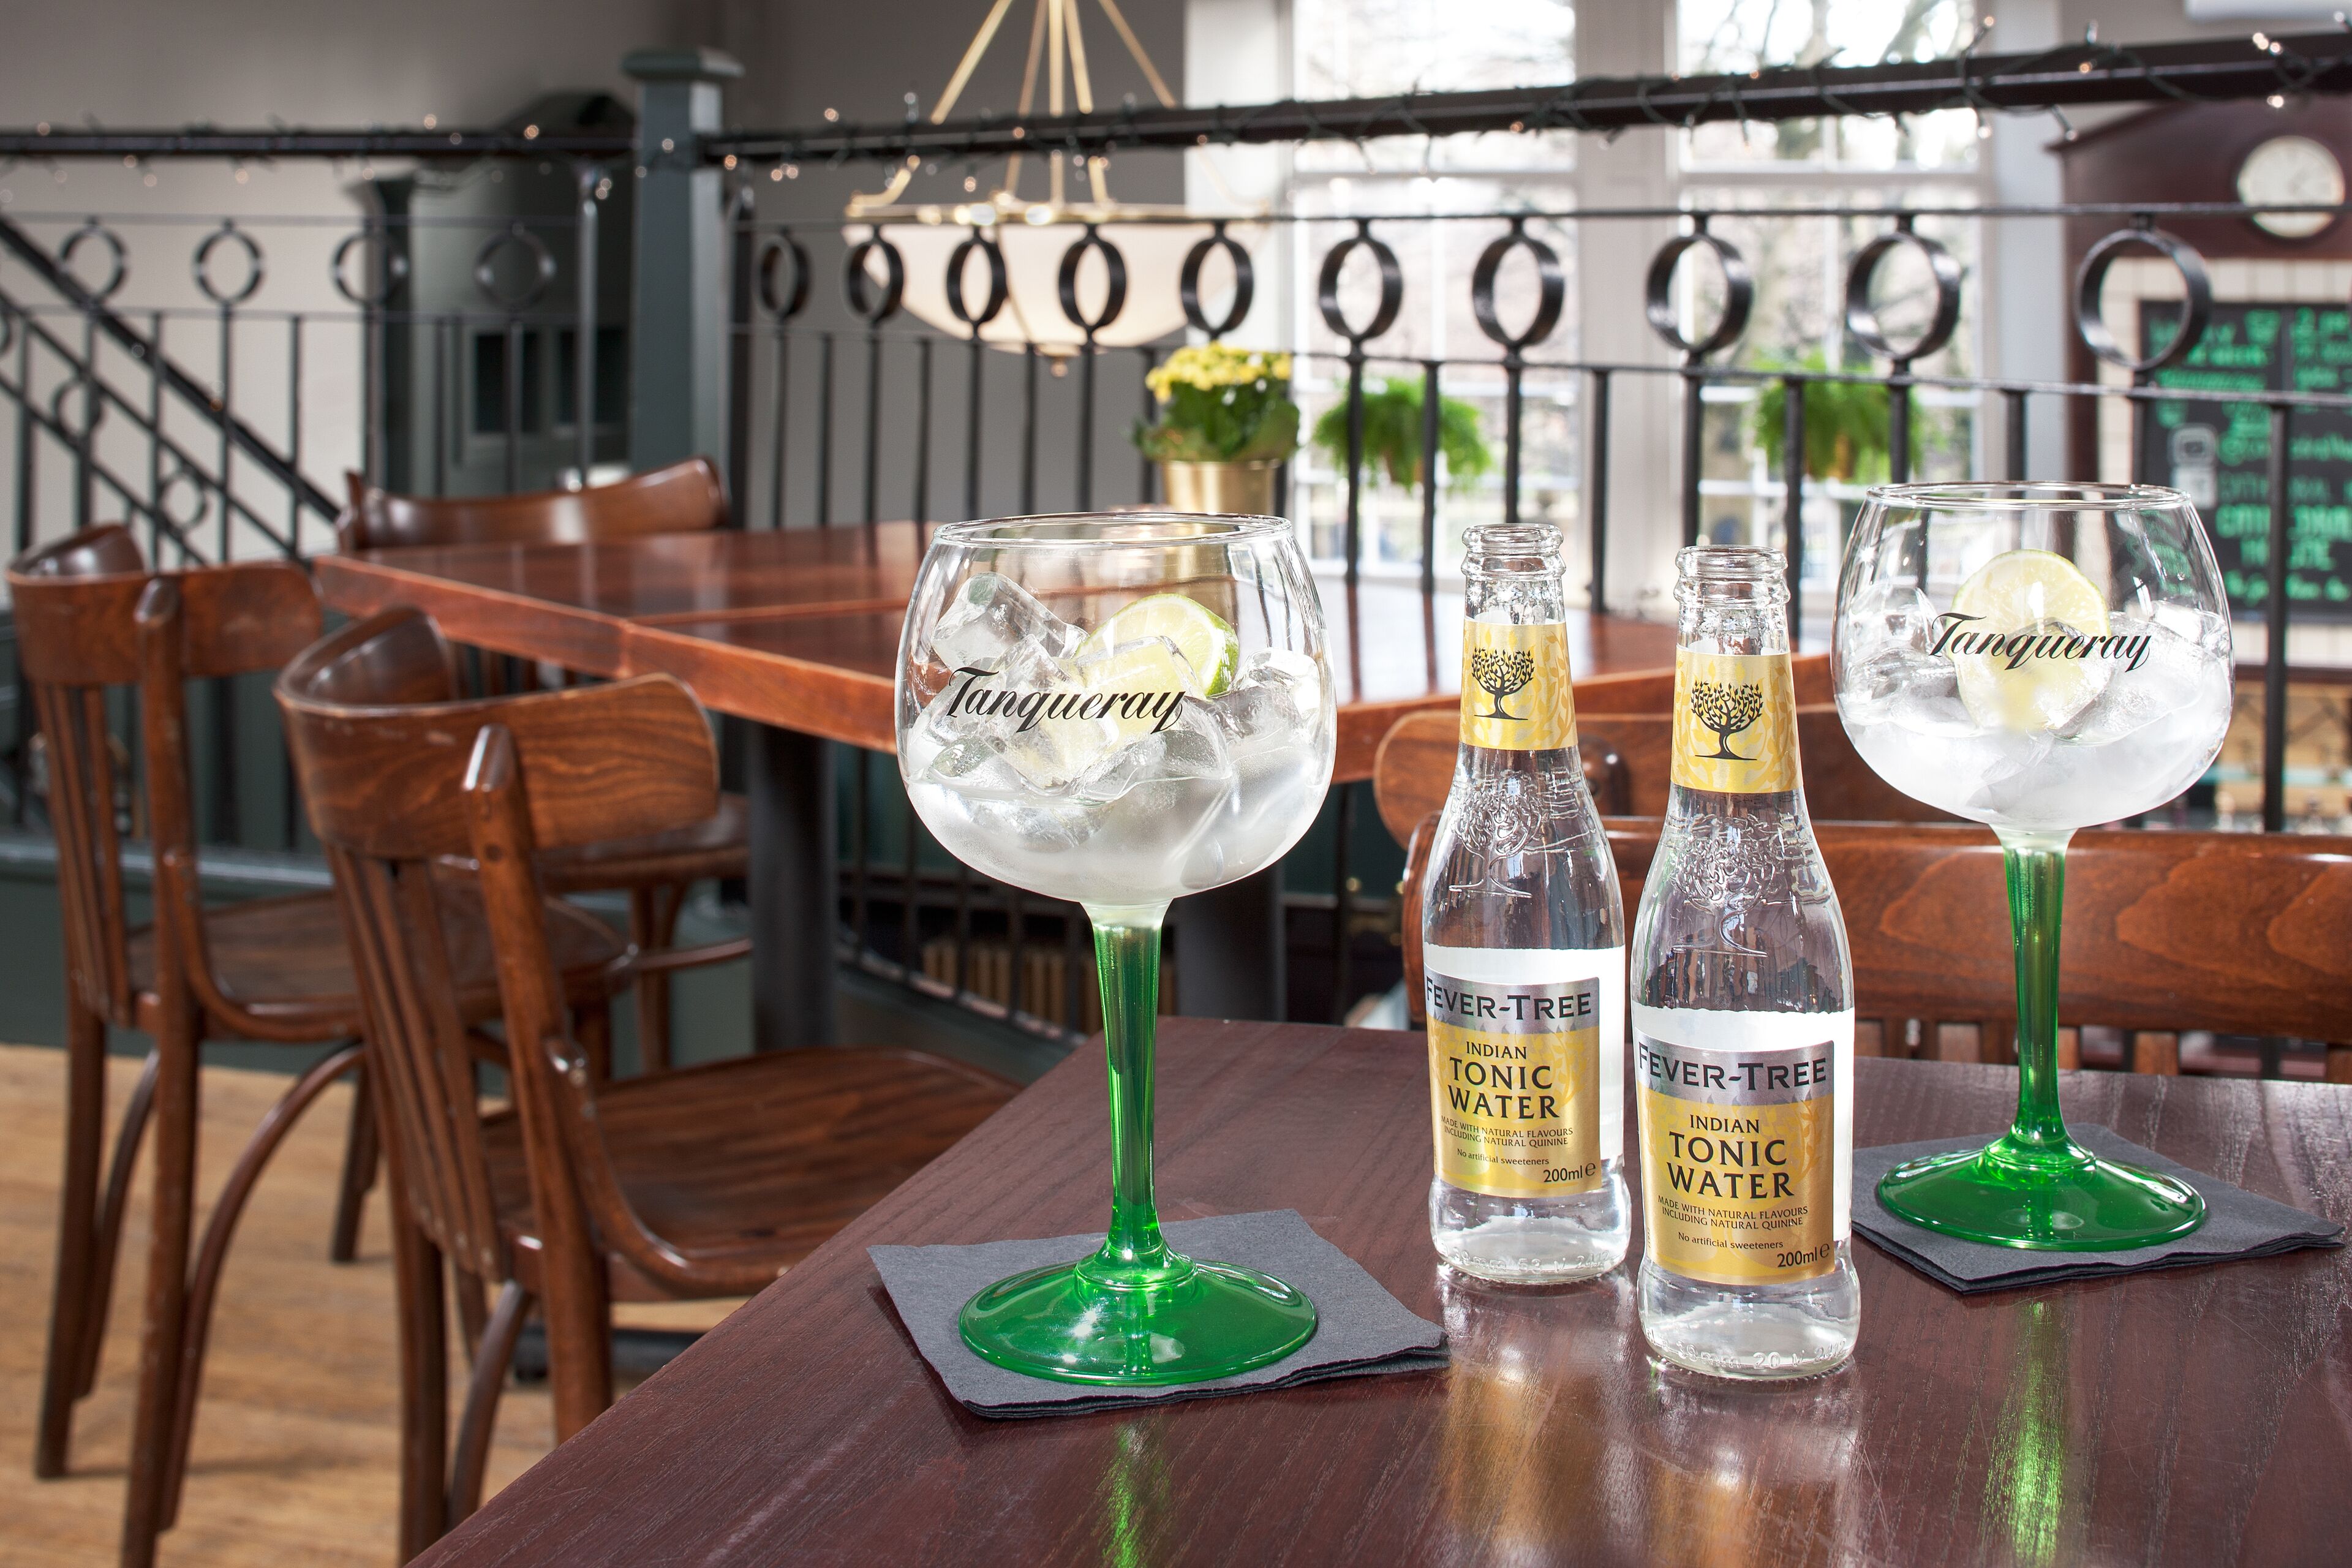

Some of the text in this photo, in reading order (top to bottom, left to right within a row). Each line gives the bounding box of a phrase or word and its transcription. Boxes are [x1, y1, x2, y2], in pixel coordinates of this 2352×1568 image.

[1929, 612, 2152, 673] Tanqueray
[946, 666, 1186, 734] Tanqueray
[1426, 975, 1592, 1020] FEVER-TREE
[1466, 1041, 1527, 1060] INDIAN
[1449, 1057, 1553, 1090] TONIC
[1638, 1041, 1826, 1090] FEVER-TREE
[1447, 1084, 1560, 1119] WATER
[1441, 1115, 1573, 1138] MADE WITH NATURAL FLAVOURS
[1689, 1114, 1760, 1133] INDIAN
[1444, 1126, 1568, 1148] INCLUDING NATURAL QUININE
[1668, 1131, 1787, 1167] TONIC
[1457, 1148, 1467, 1158] No
[1468, 1152, 1498, 1163] artificial
[1543, 1166, 1583, 1183] 200ml
[1666, 1161, 1795, 1199] WATER
[1657, 1194, 1808, 1219] MADE WITH NATURAL FLAVOURS
[1662, 1207, 1803, 1231] INCLUDING NATURAL QUININE
[1678, 1232, 1784, 1250] No artificial sweeteners
[1777, 1246, 1817, 1268] 200ml
